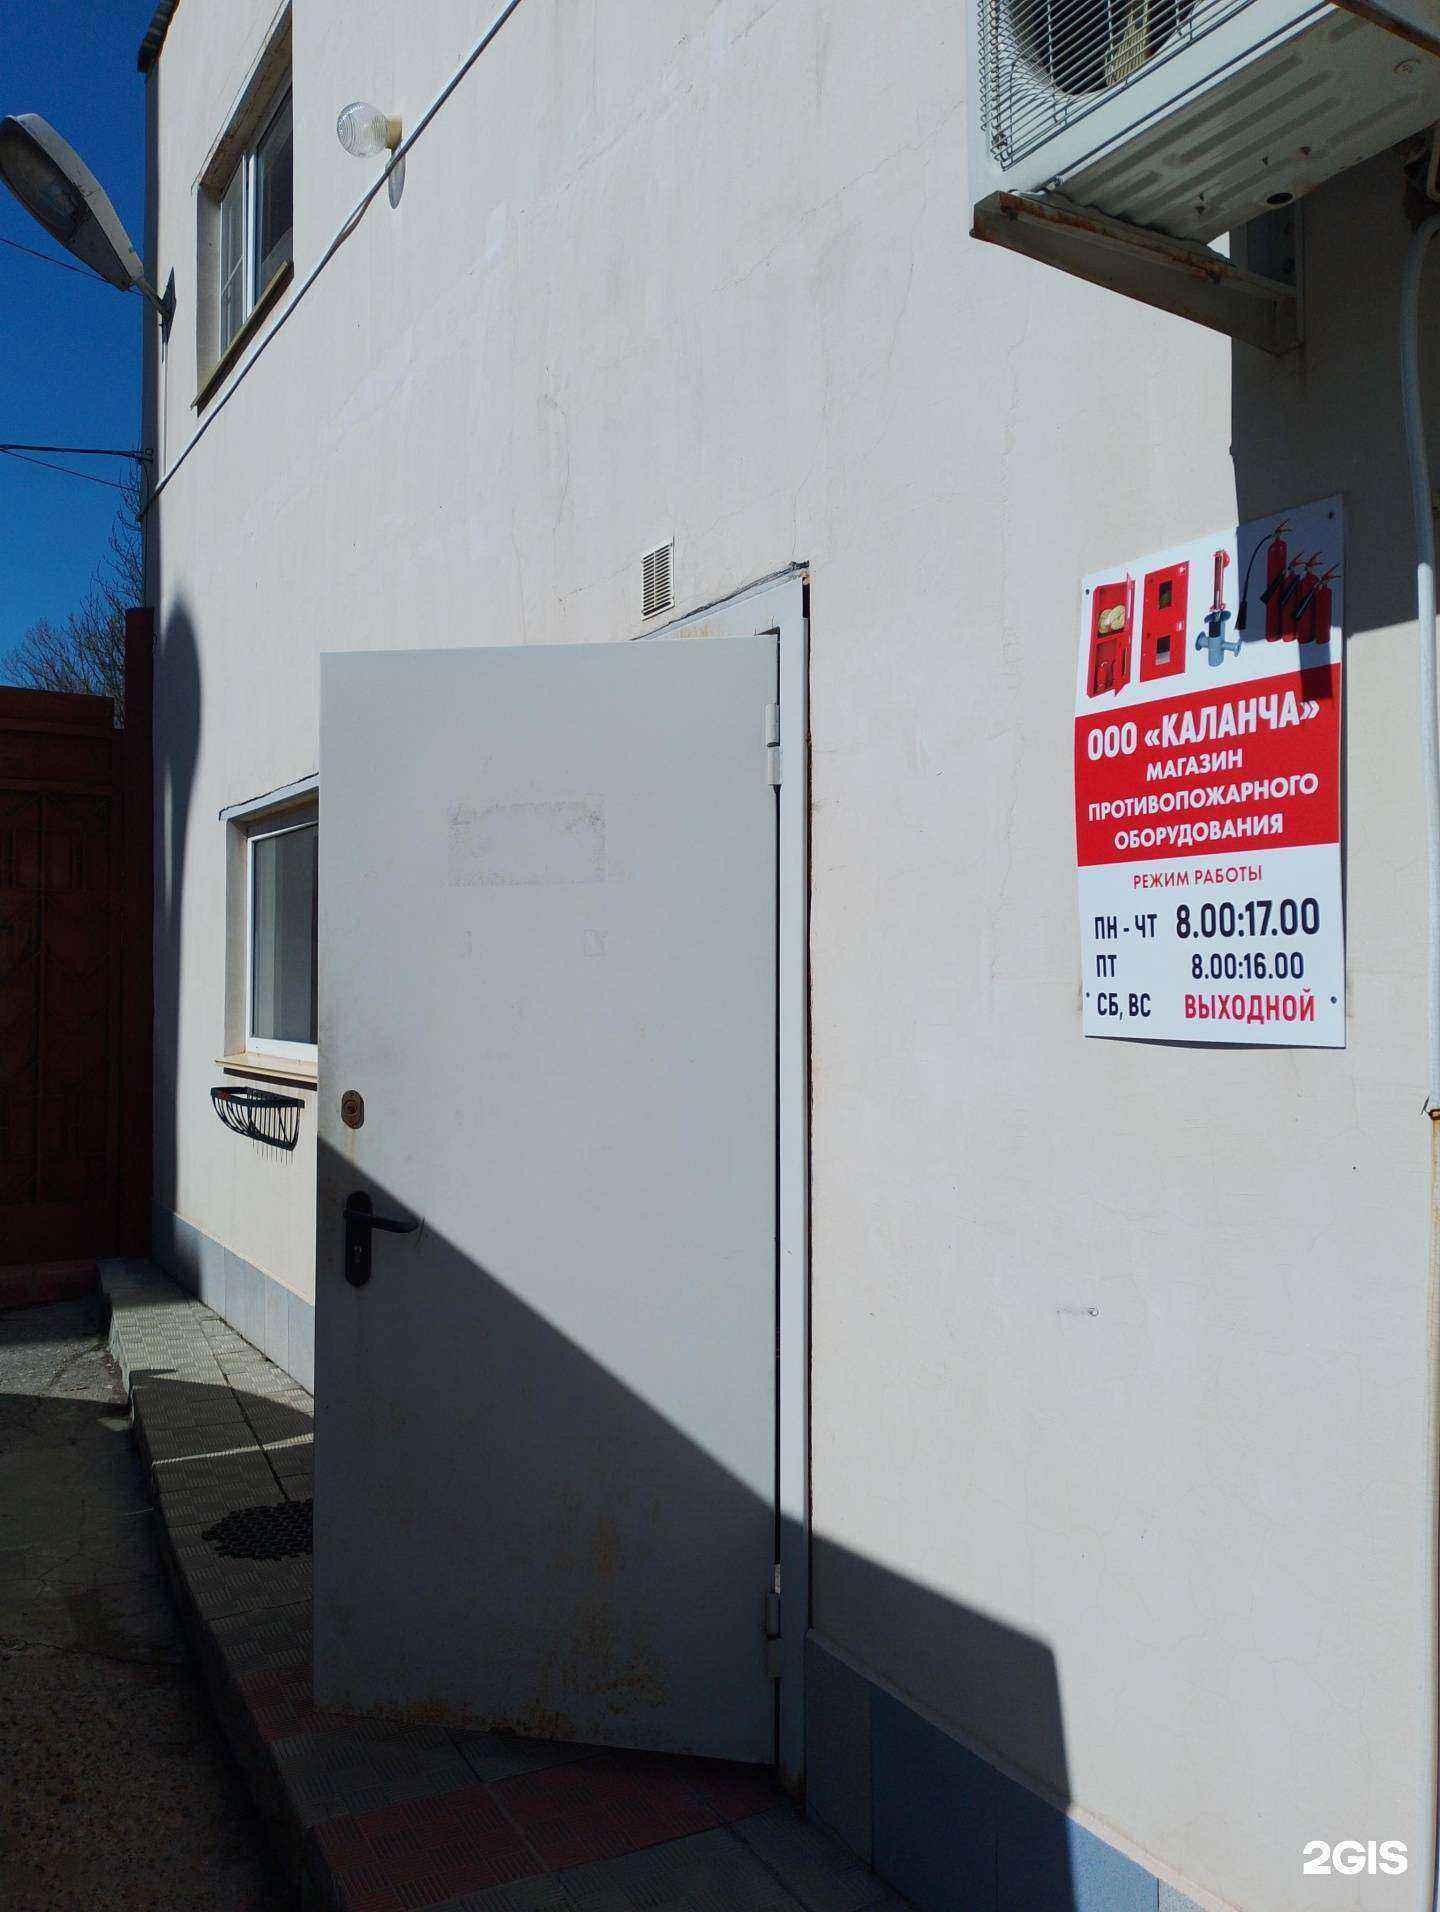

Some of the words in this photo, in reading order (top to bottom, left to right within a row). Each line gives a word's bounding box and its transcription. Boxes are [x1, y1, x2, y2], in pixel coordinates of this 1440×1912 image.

[1087, 721, 1138, 761] ООО
[1144, 690, 1321, 749] «КАЛАНЧА»
[1145, 748, 1244, 783] МАГАЗИН
[1087, 772, 1320, 822] ПРОТИВОПОЖАРНОГО
[1113, 812, 1284, 851] ОБОРУДОВАНИЯ
[1132, 871, 1190, 890] РЕЖИМ
[1194, 864, 1263, 885] РАБОТЫ
[1175, 897, 1321, 939] 8.00:17.00
[1096, 954, 1118, 978] ПТ
[1191, 951, 1305, 980] 8.00:16.00
[1097, 992, 1123, 1021] СБ,
[1128, 992, 1152, 1018] ВС
[1184, 987, 1316, 1025] ВЫХОДНОЙ
